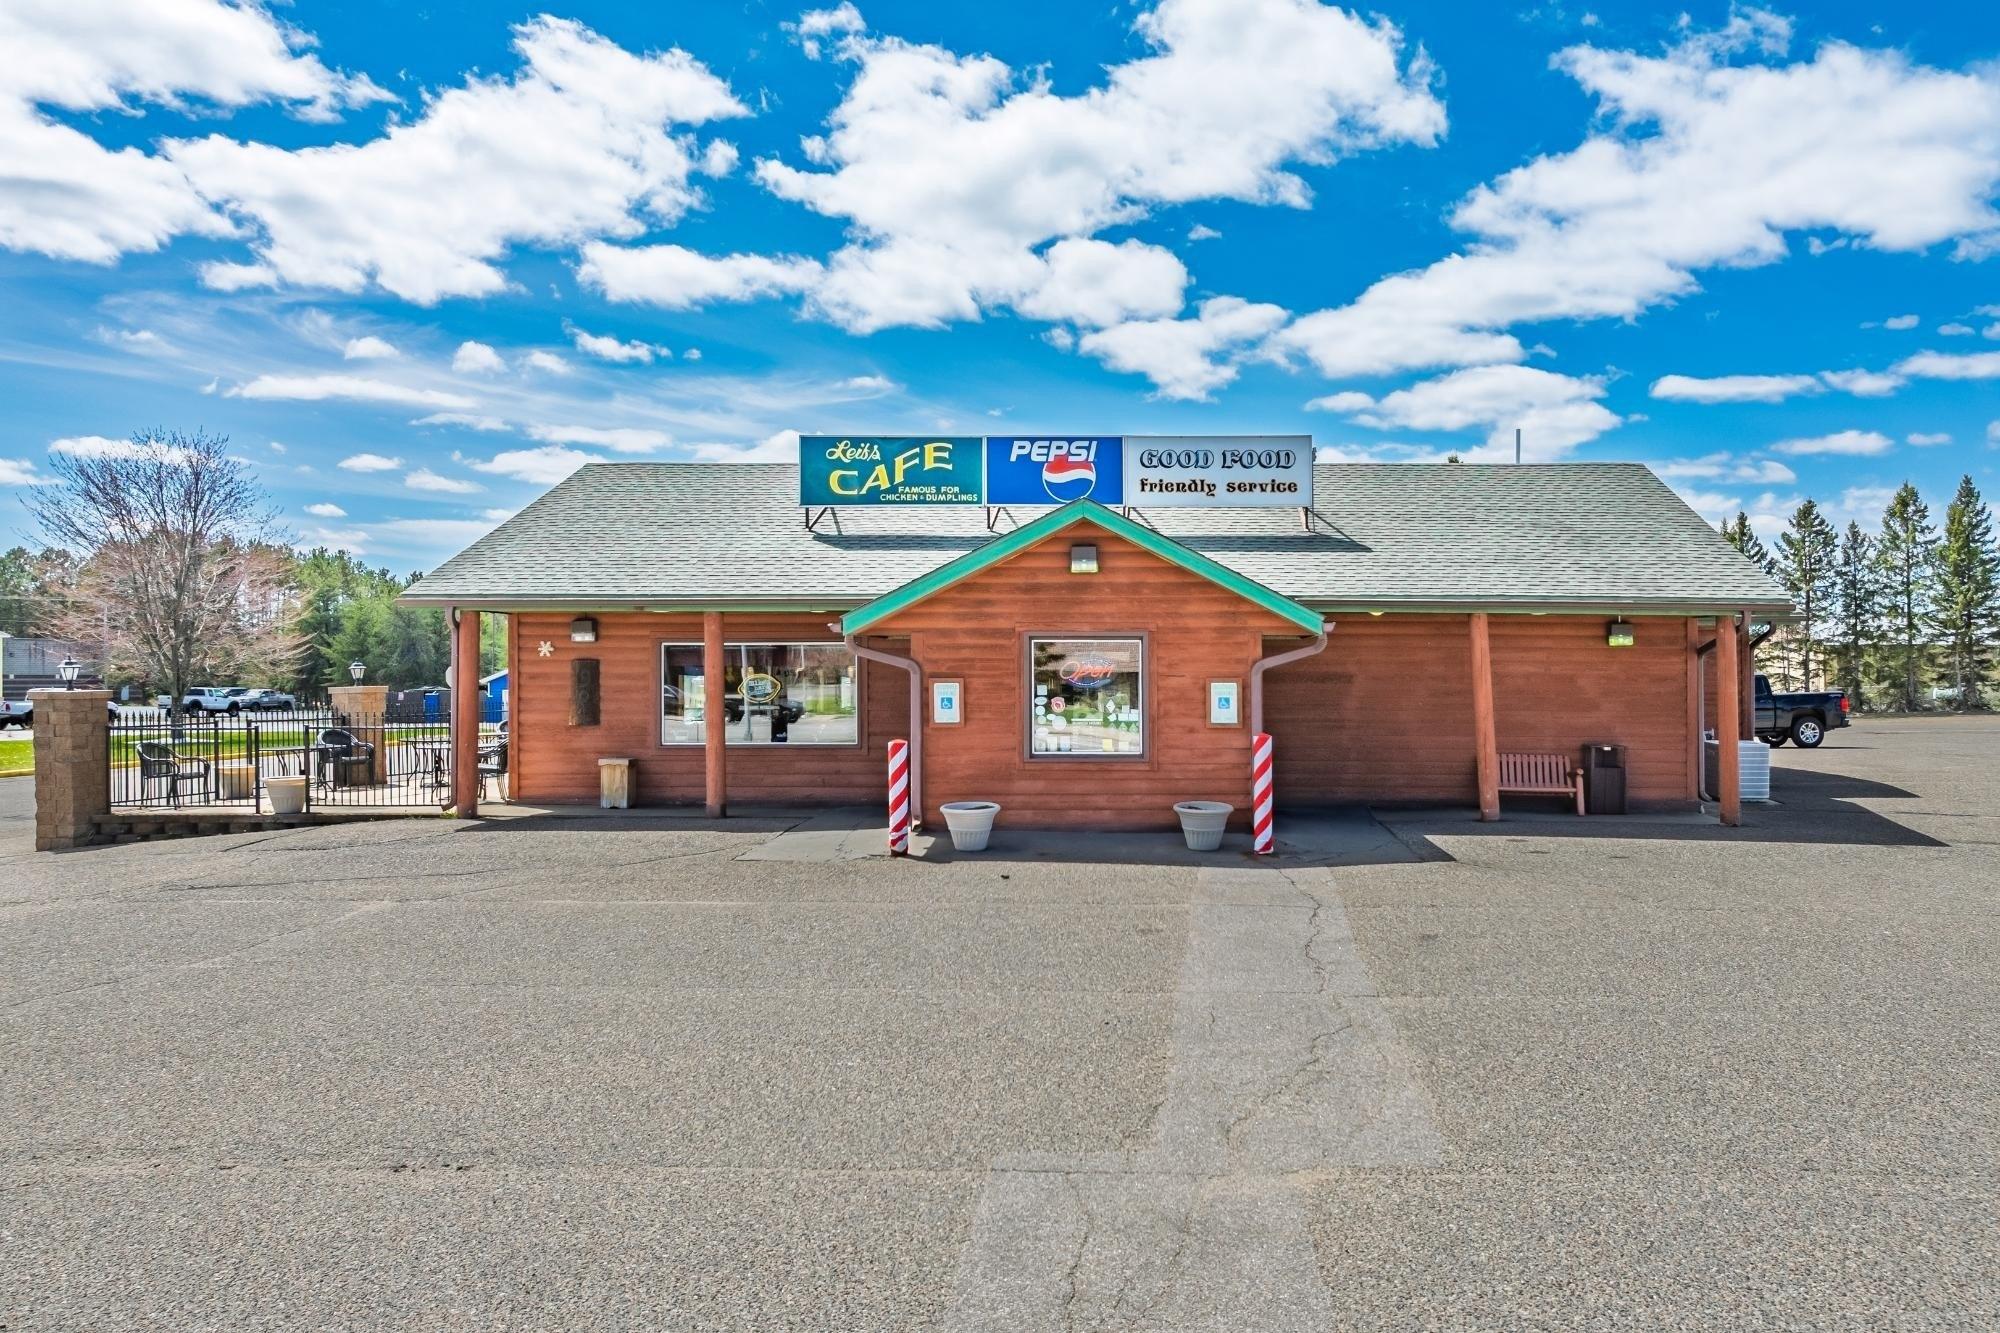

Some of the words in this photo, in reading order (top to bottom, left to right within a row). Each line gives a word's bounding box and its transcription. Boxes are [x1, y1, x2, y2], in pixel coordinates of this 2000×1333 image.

[1010, 440, 1098, 462] PEPSI
[1139, 449, 1214, 469] GOOD
[1221, 449, 1296, 469] FOOD
[829, 442, 953, 495] CAFE
[898, 486, 937, 494] FAMOUS
[941, 486, 960, 494] FOR
[1226, 479, 1298, 493] service
[925, 493, 978, 502] DUMPLINGS
